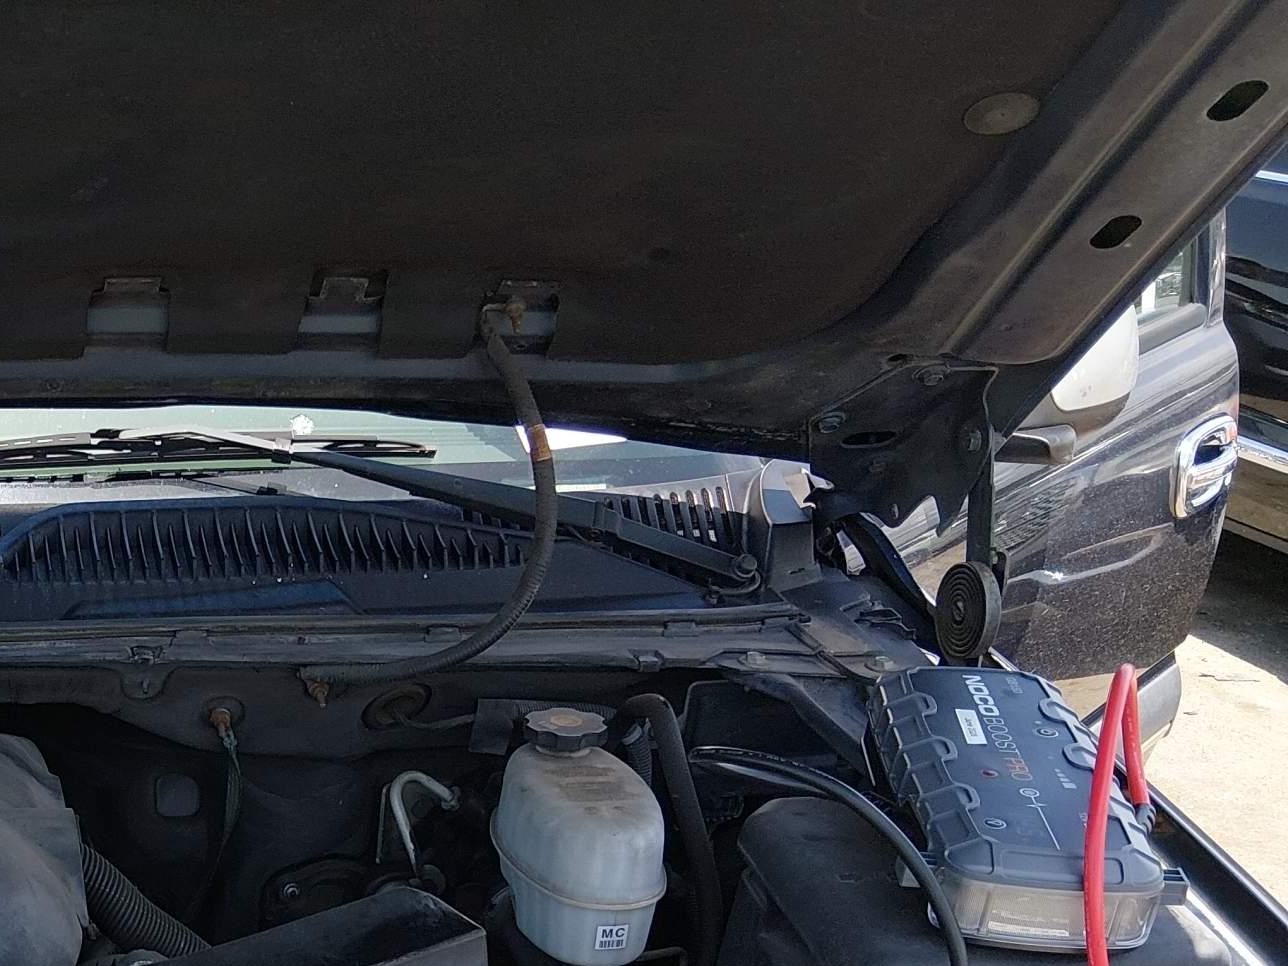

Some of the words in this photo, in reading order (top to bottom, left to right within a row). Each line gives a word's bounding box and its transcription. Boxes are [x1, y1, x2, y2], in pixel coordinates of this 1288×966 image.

[962, 674, 1000, 717] NOCO
[983, 717, 1022, 759] BOOST
[601, 927, 626, 939] MC
